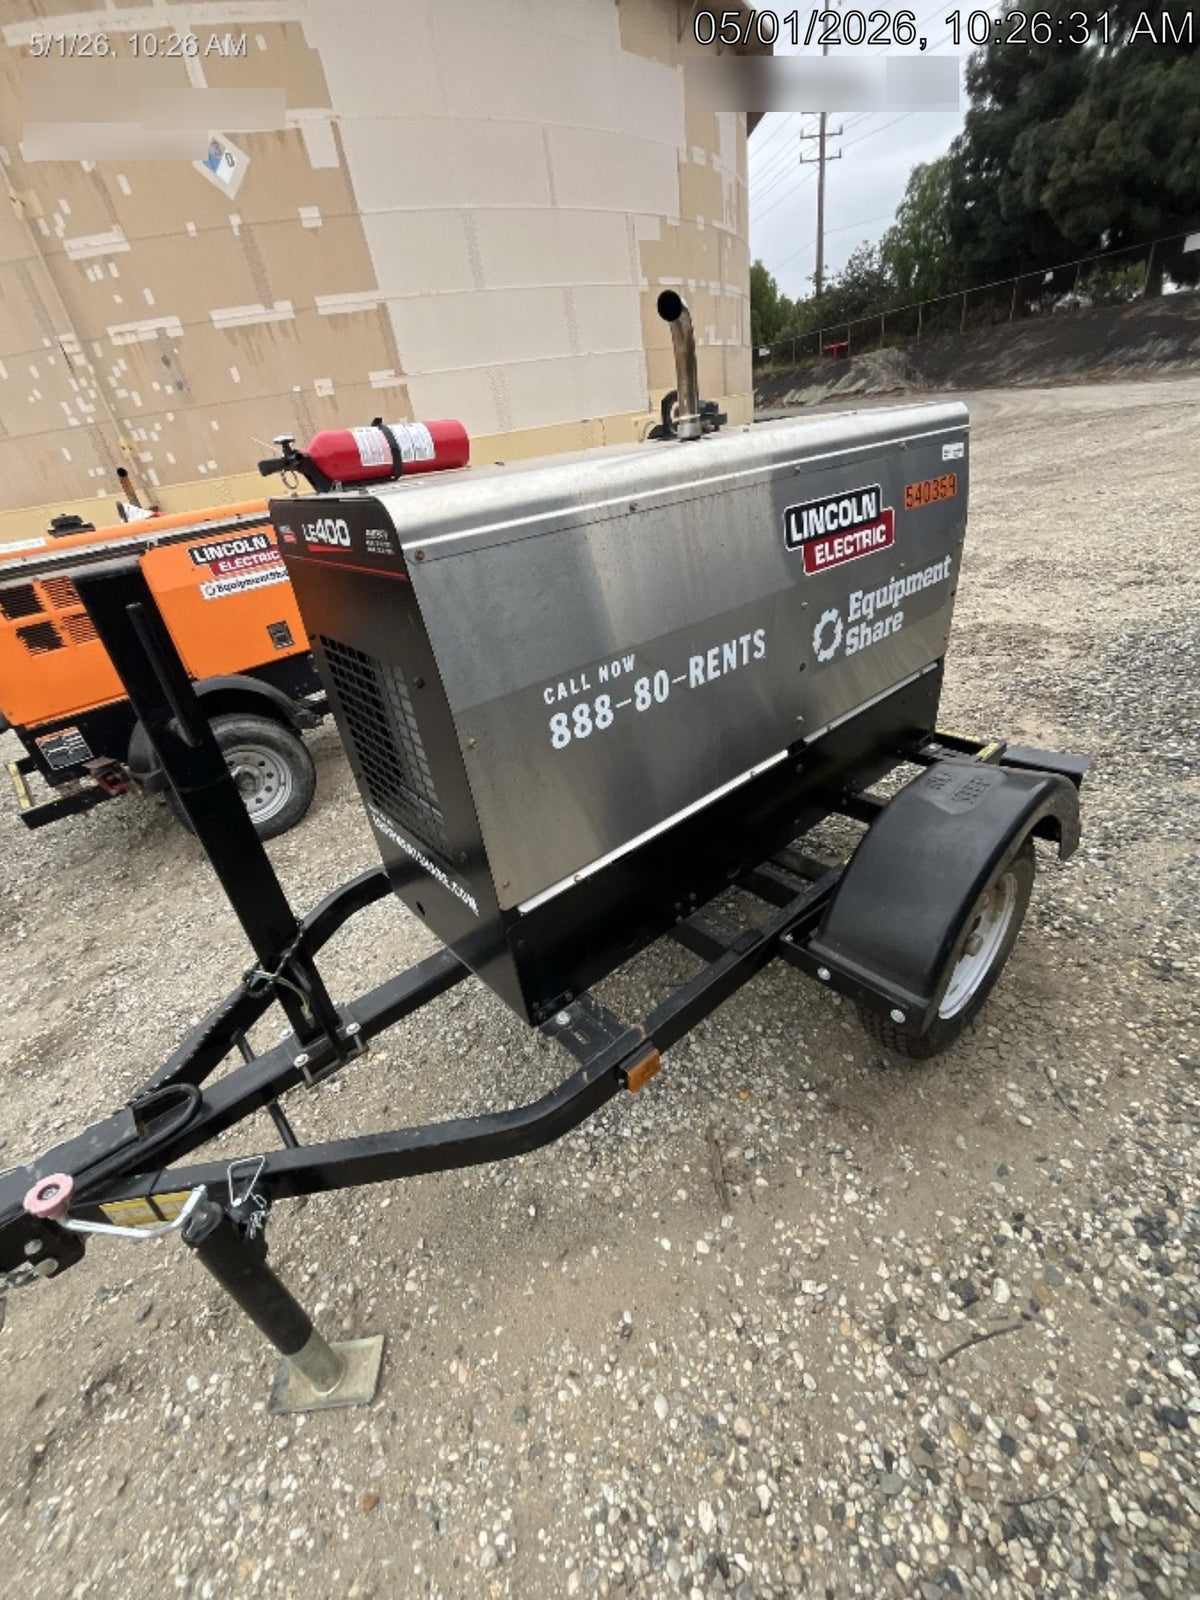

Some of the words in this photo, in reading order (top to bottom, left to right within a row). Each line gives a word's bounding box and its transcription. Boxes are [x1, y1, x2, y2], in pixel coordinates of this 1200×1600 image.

[905, 474, 956, 508] 540359
[790, 492, 877, 542] LINCOLN
[193, 535, 267, 563] LINCOLN
[218, 550, 280, 573] ELECTRIC
[814, 524, 887, 566] ELECTRIC
[847, 554, 952, 622] Equipment
[845, 611, 904, 657] Share
[543, 673, 591, 705] CALL
[598, 653, 635, 683] NOW
[549, 628, 766, 750] 888-80-RENTS
